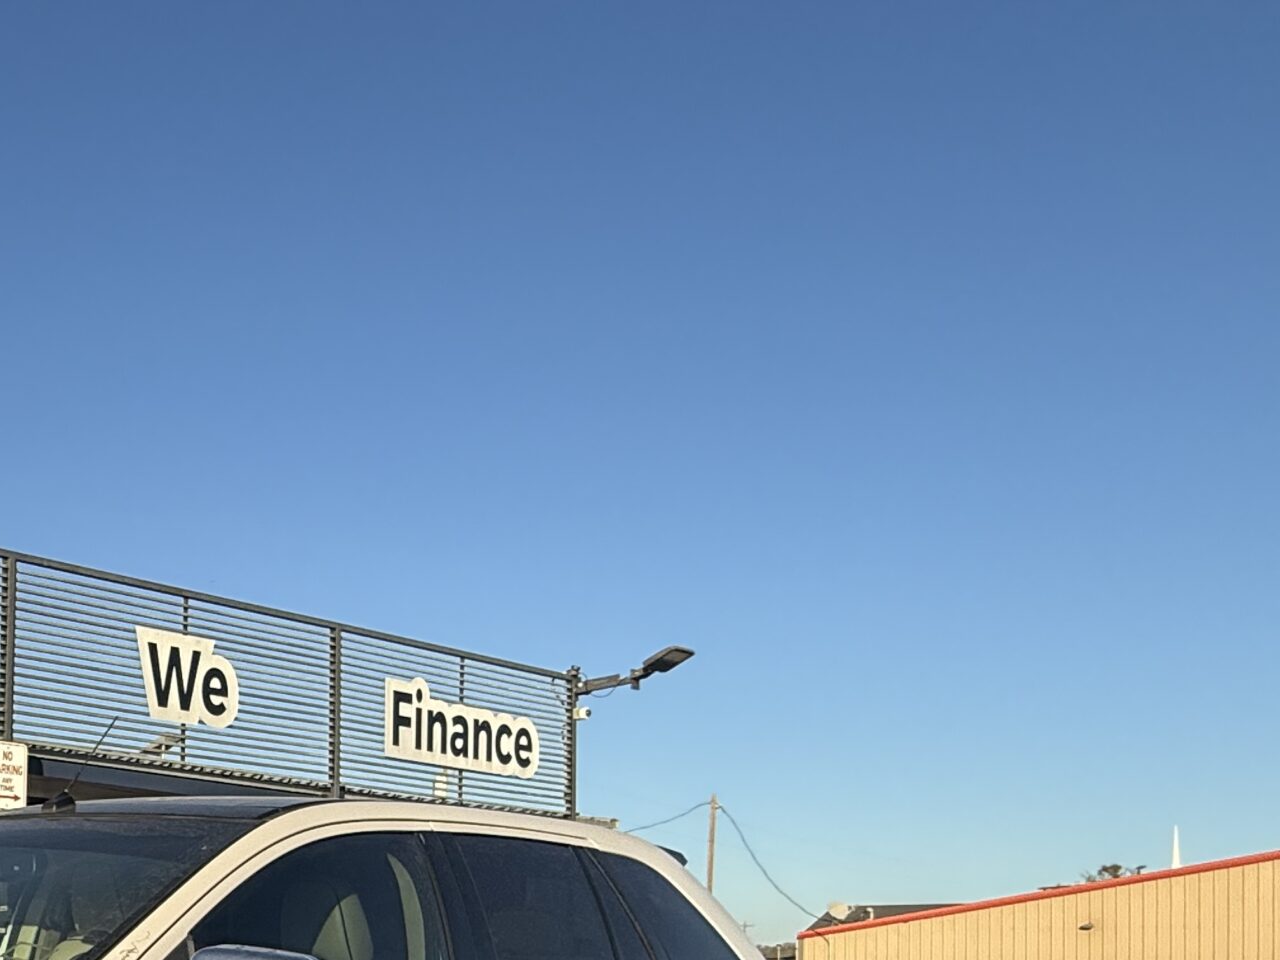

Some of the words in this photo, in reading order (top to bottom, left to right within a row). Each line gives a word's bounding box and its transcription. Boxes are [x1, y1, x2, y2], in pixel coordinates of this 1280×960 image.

[148, 642, 229, 716] We
[392, 688, 533, 769] Finance
[2, 750, 13, 761] NO
[0, 784, 14, 792] TIME
